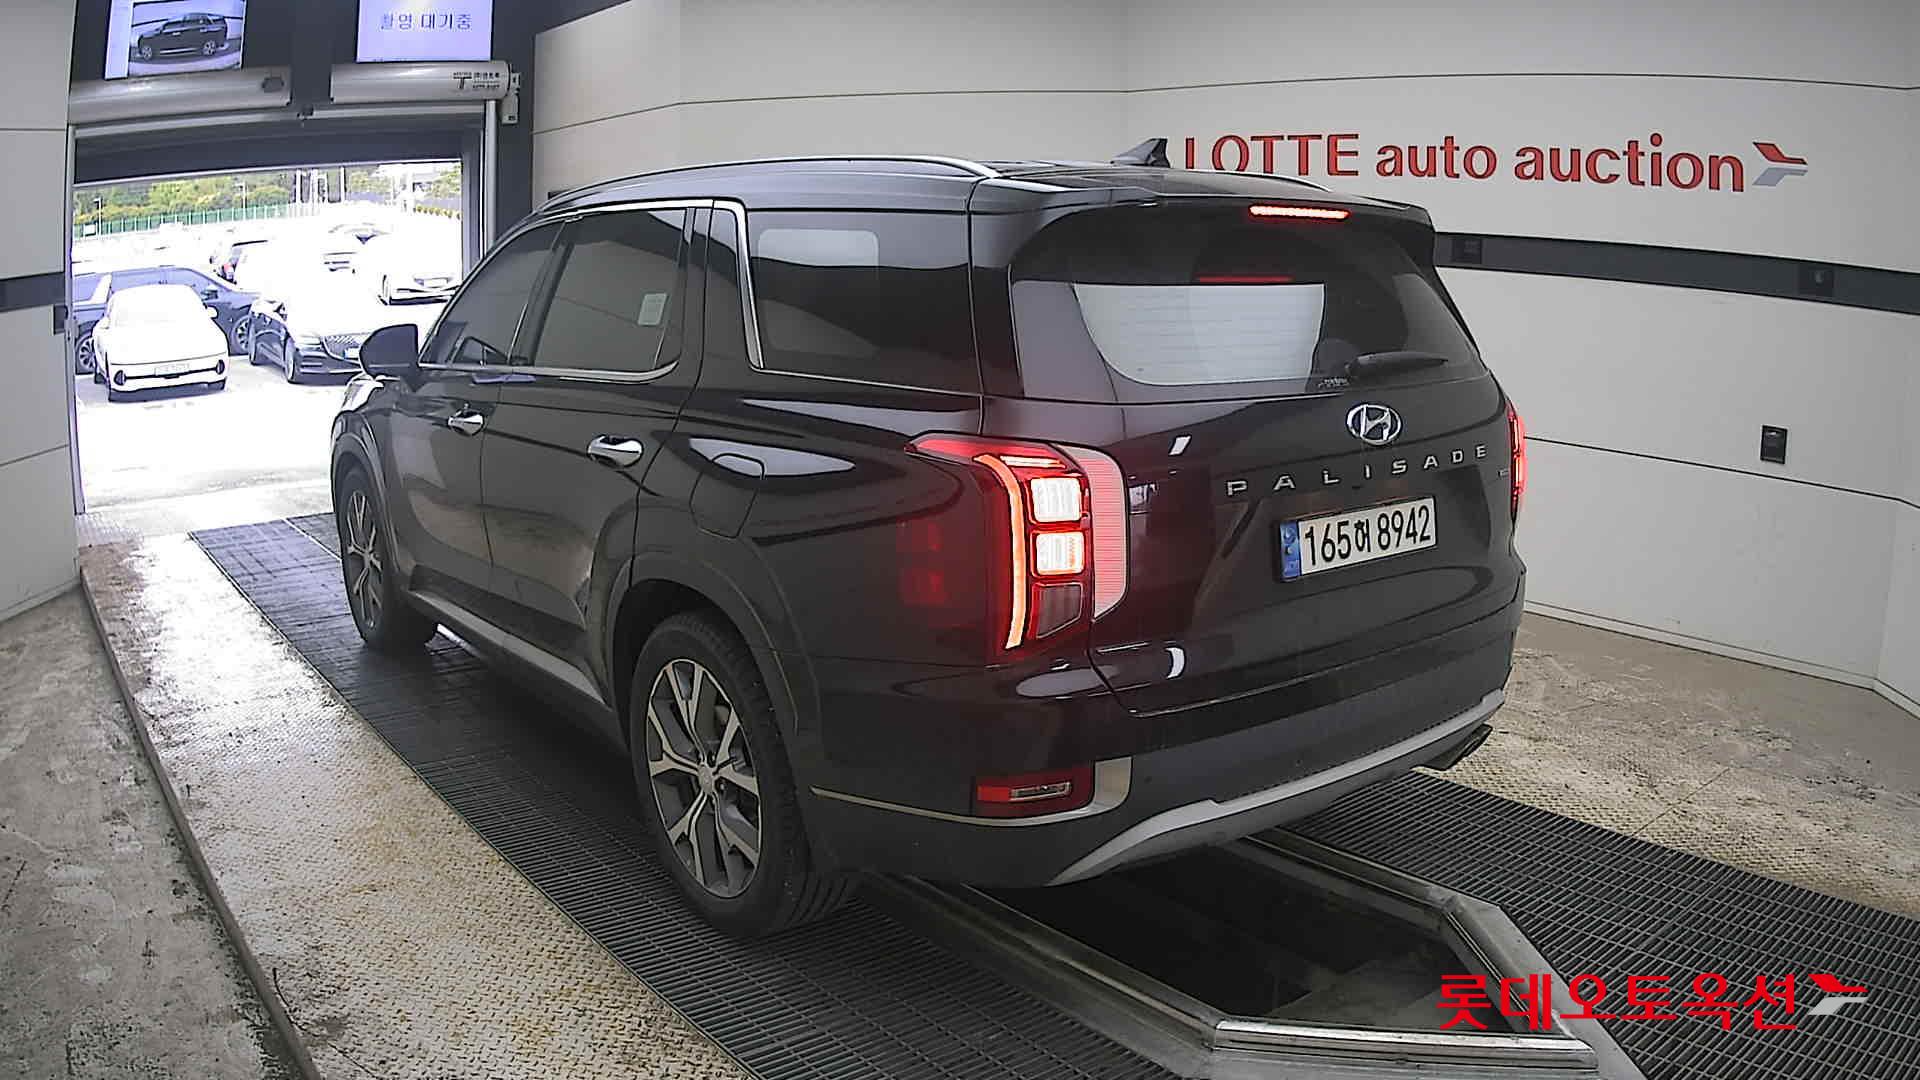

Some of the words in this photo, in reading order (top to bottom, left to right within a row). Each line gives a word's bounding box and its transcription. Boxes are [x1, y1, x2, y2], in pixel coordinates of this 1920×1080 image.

[420, 12, 472, 30] 대기중
[1375, 136, 1499, 179] auto
[1513, 133, 1746, 192] auction
[1226, 444, 1488, 496] PALISADE
